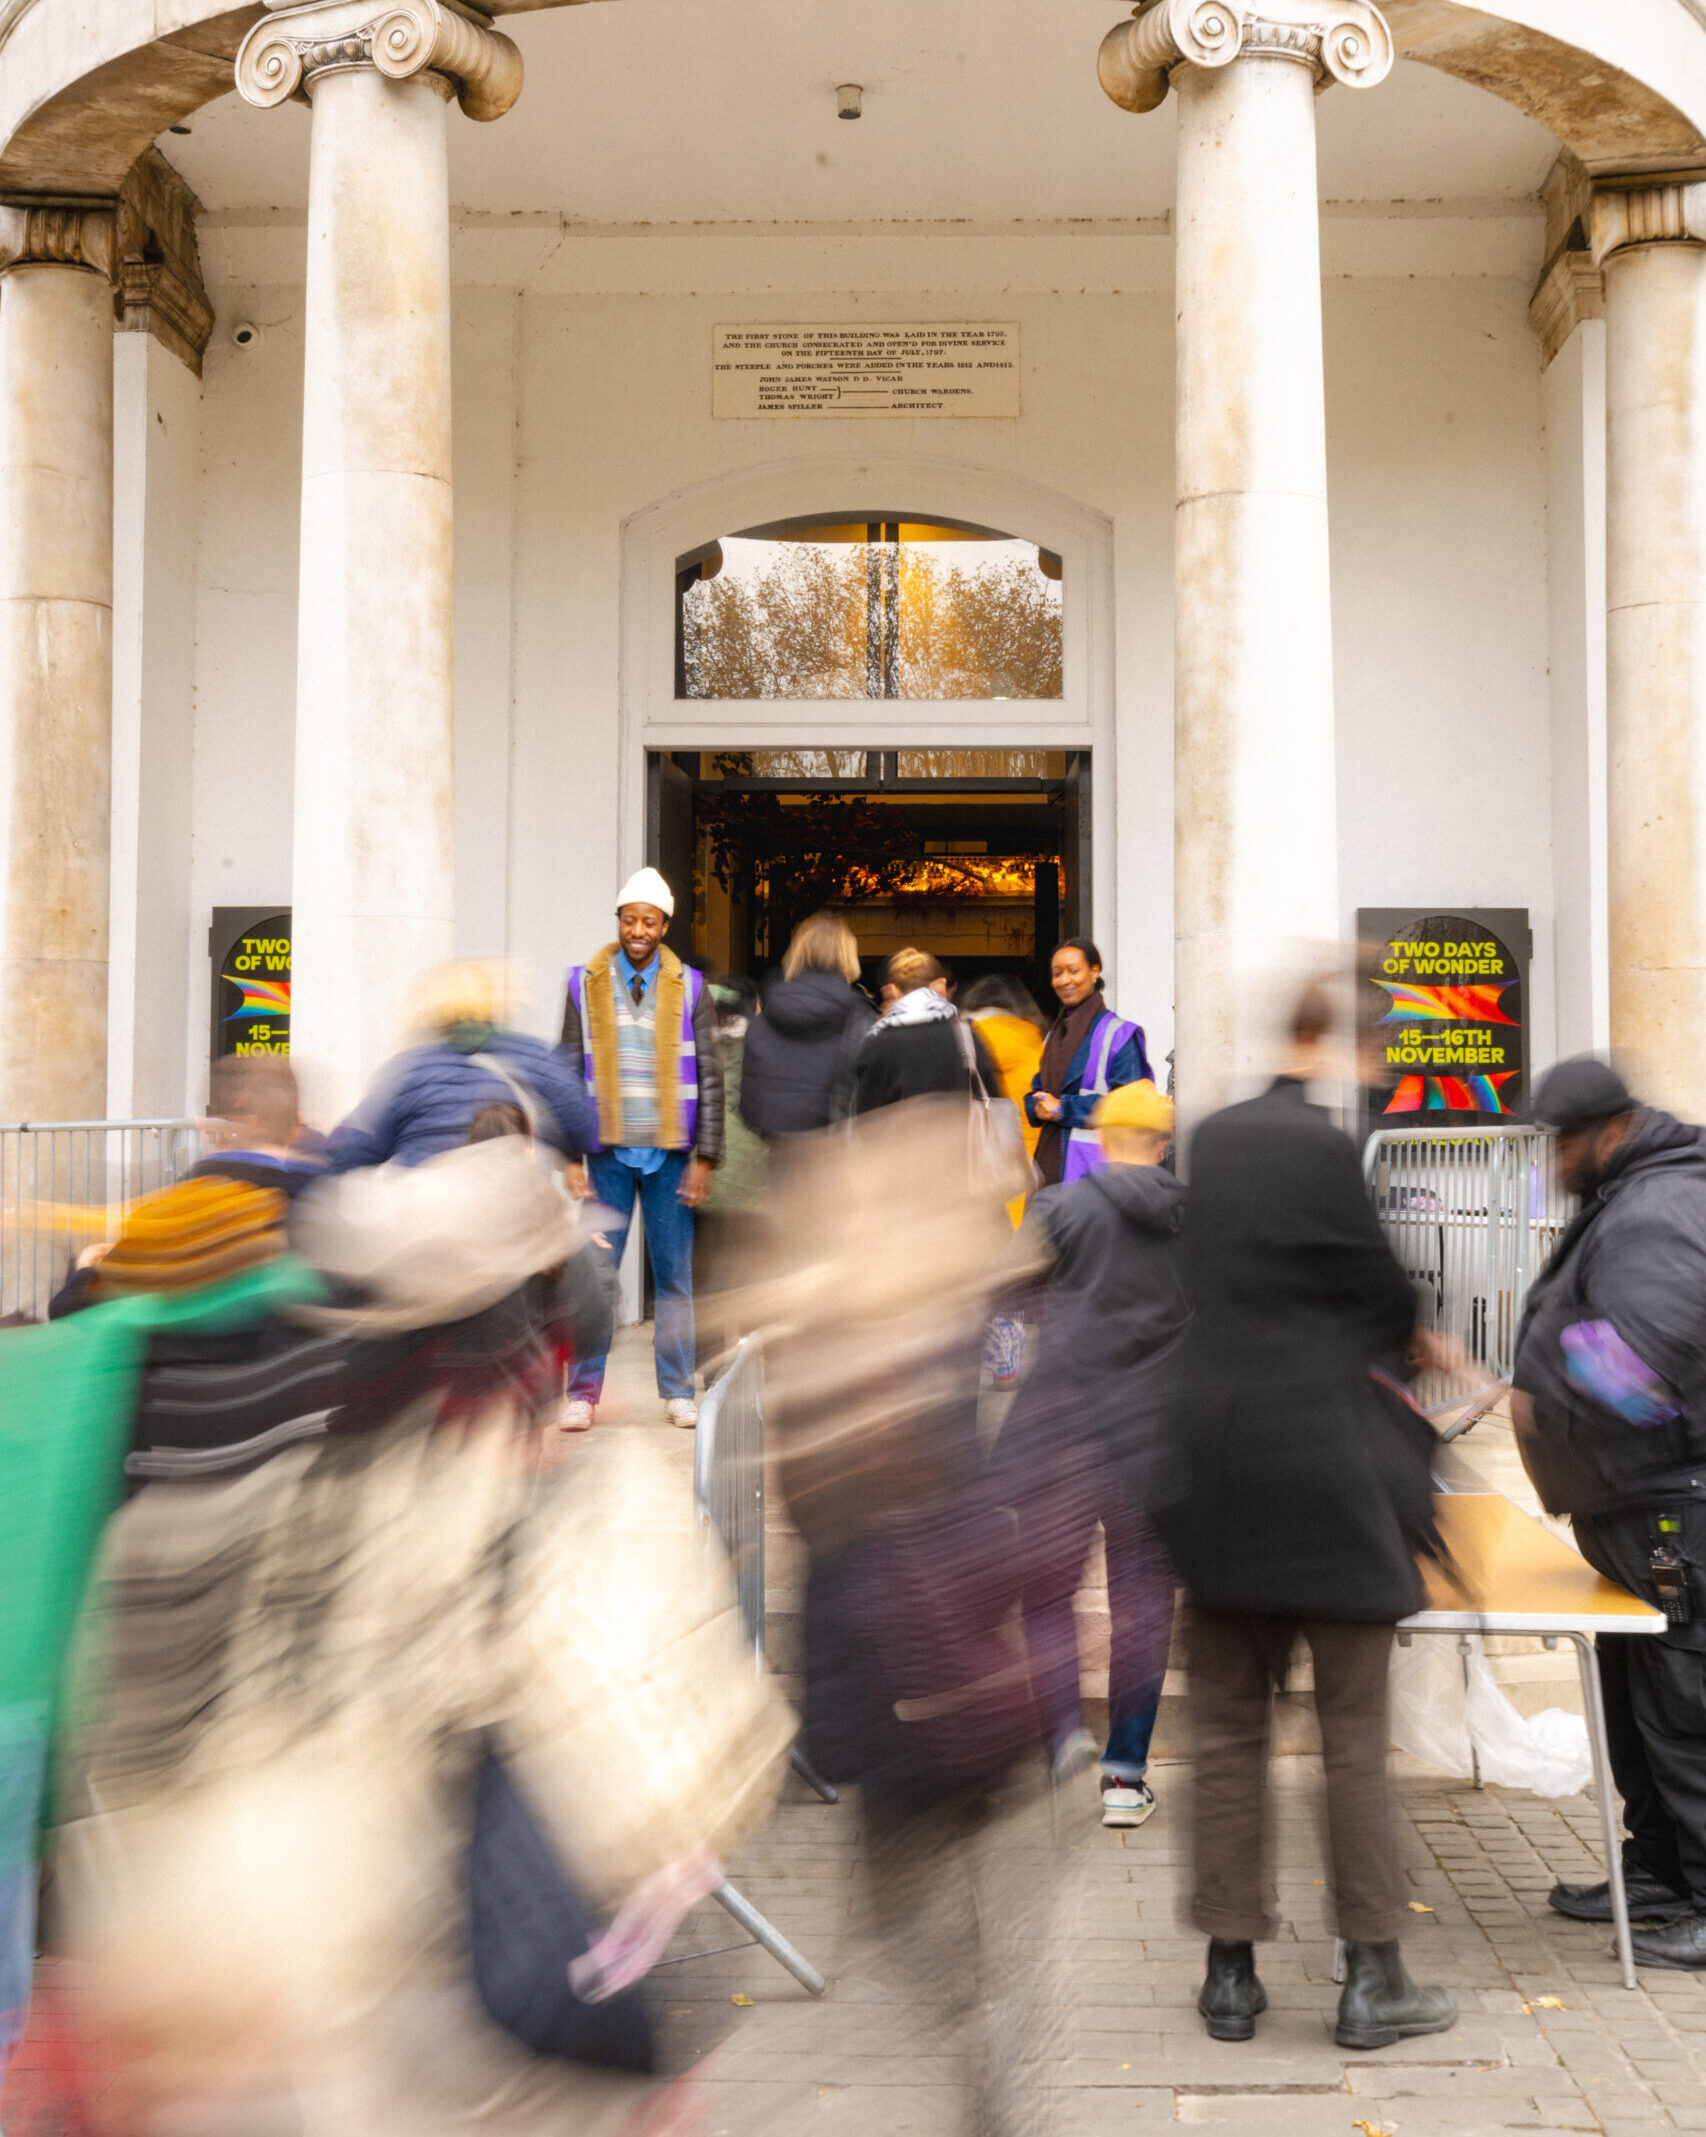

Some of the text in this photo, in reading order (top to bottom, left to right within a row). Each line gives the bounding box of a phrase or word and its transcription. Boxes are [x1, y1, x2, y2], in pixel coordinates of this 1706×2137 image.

[242, 939, 290, 954] TWO
[1390, 942, 1497, 957] TWO DAYS
[235, 955, 261, 971] OF
[1383, 958, 1504, 974] OF WONDER
[1386, 1047, 1505, 1063] NOVEMBER
